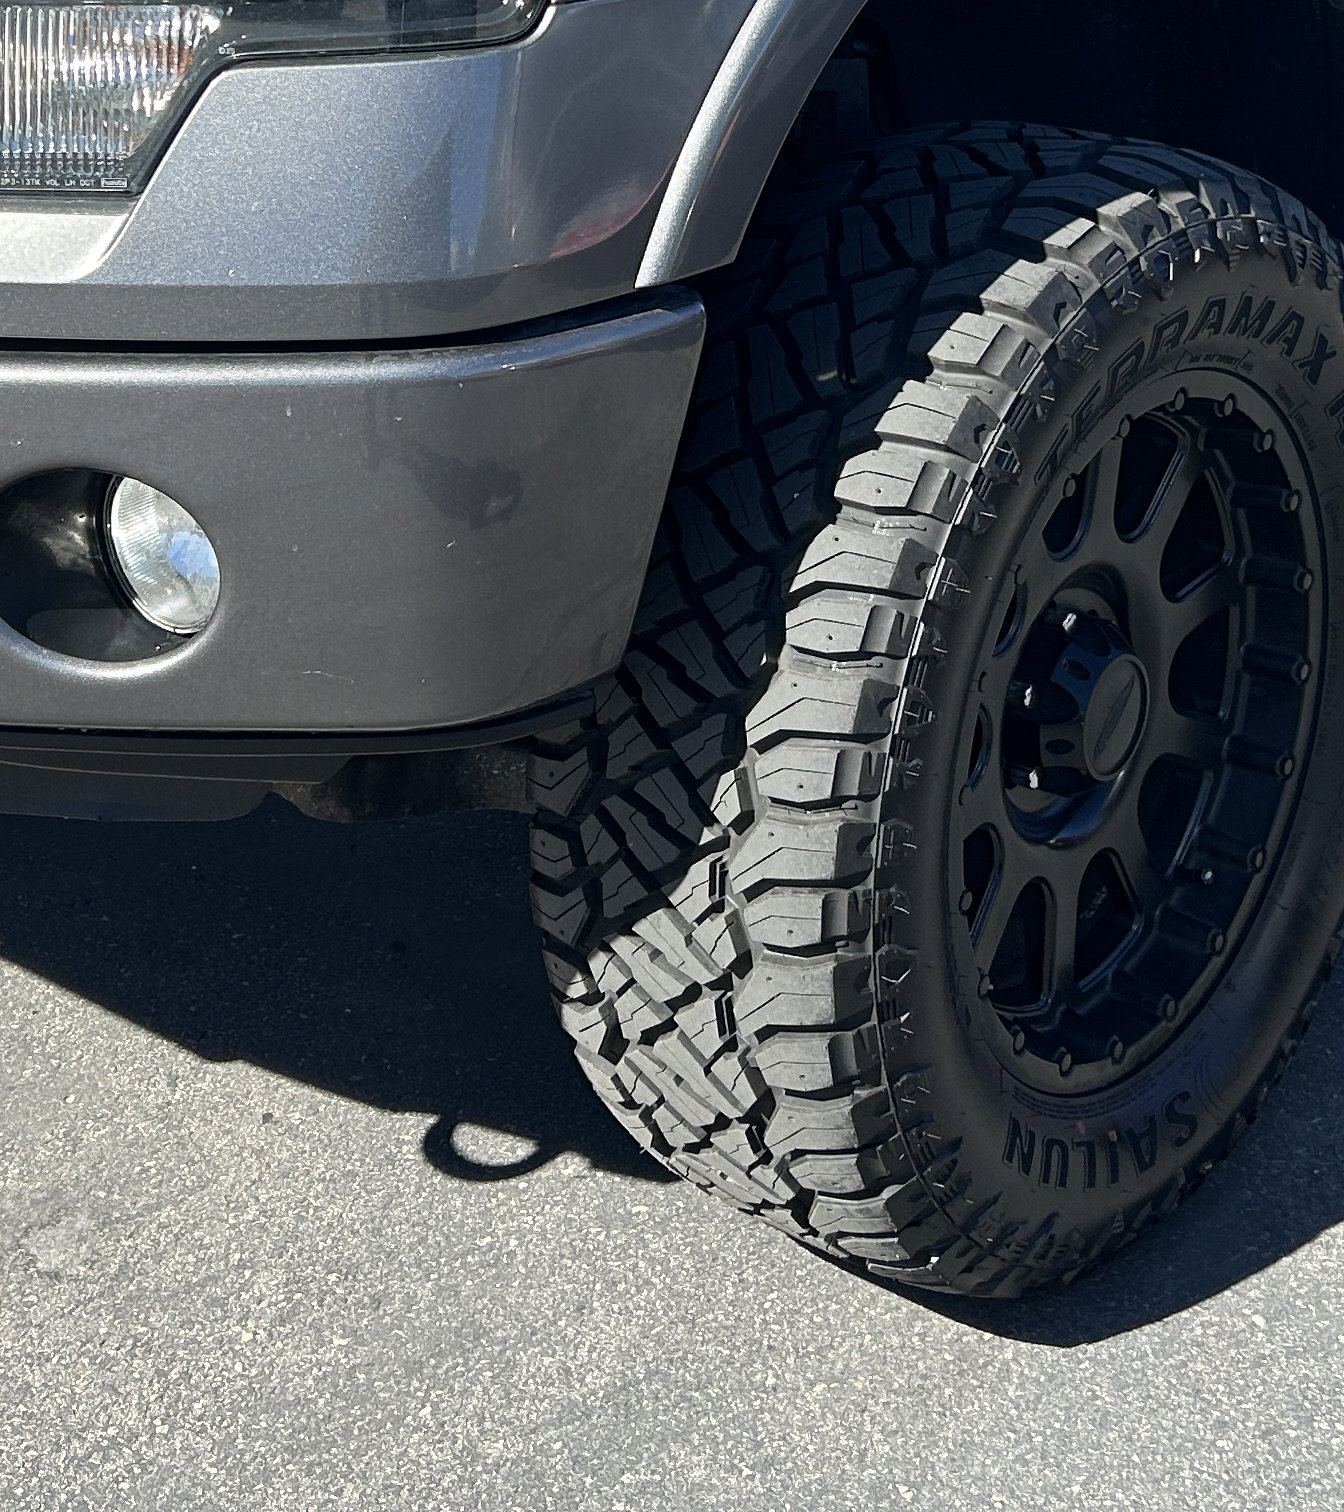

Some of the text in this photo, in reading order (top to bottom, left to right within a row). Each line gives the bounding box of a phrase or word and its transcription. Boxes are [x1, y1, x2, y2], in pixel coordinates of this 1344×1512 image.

[64, 178, 76, 186] LH
[1033, 291, 1338, 487] TERRAMAX
[1002, 1090, 1200, 1189] SAILUN
